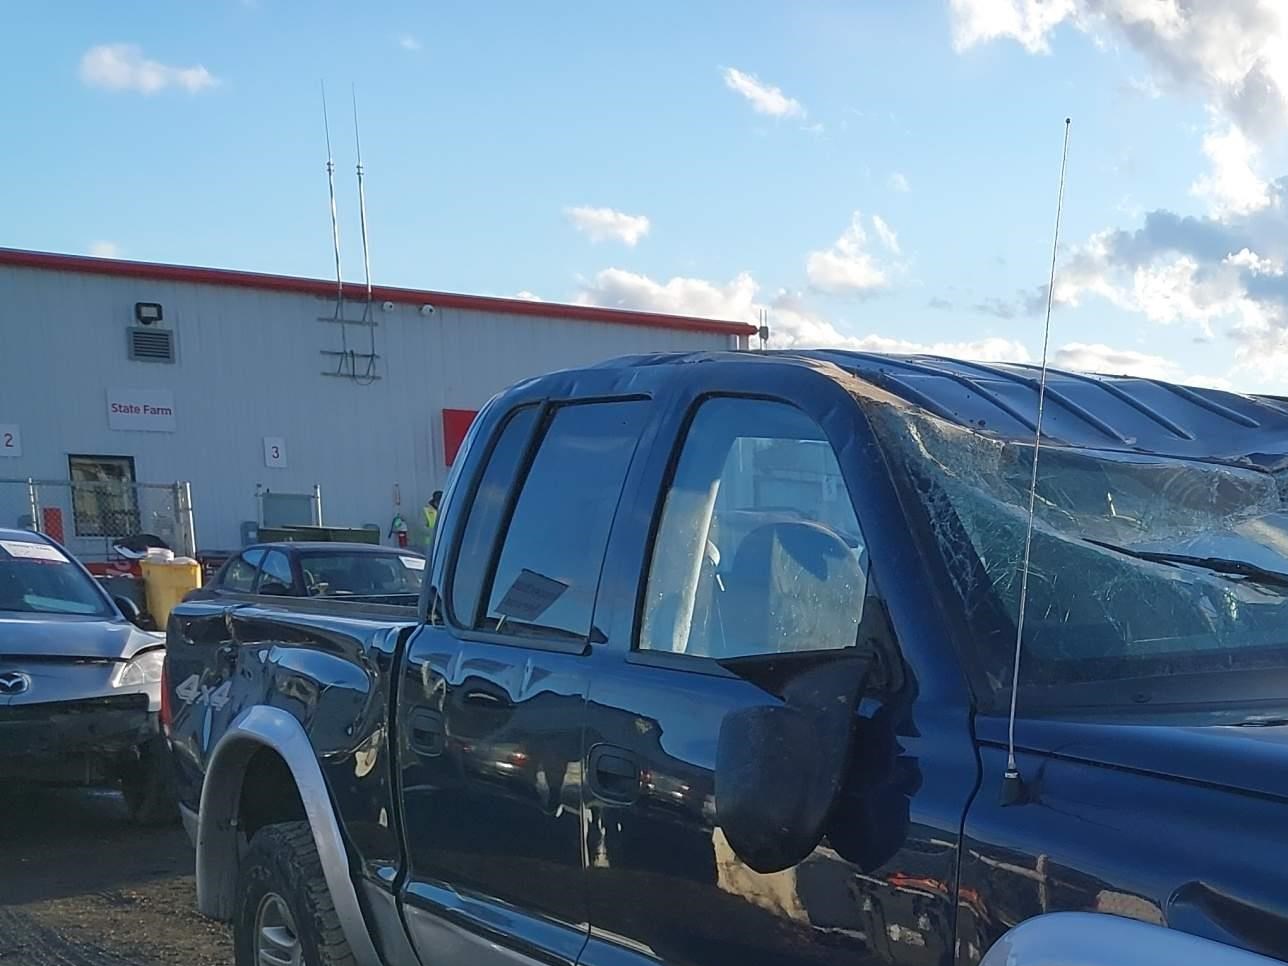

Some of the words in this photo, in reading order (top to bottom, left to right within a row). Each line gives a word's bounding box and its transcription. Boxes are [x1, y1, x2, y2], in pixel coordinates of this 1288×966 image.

[111, 402, 141, 415] State
[143, 404, 172, 416] Farm
[4, 432, 14, 448] 2
[272, 446, 280, 459] 3
